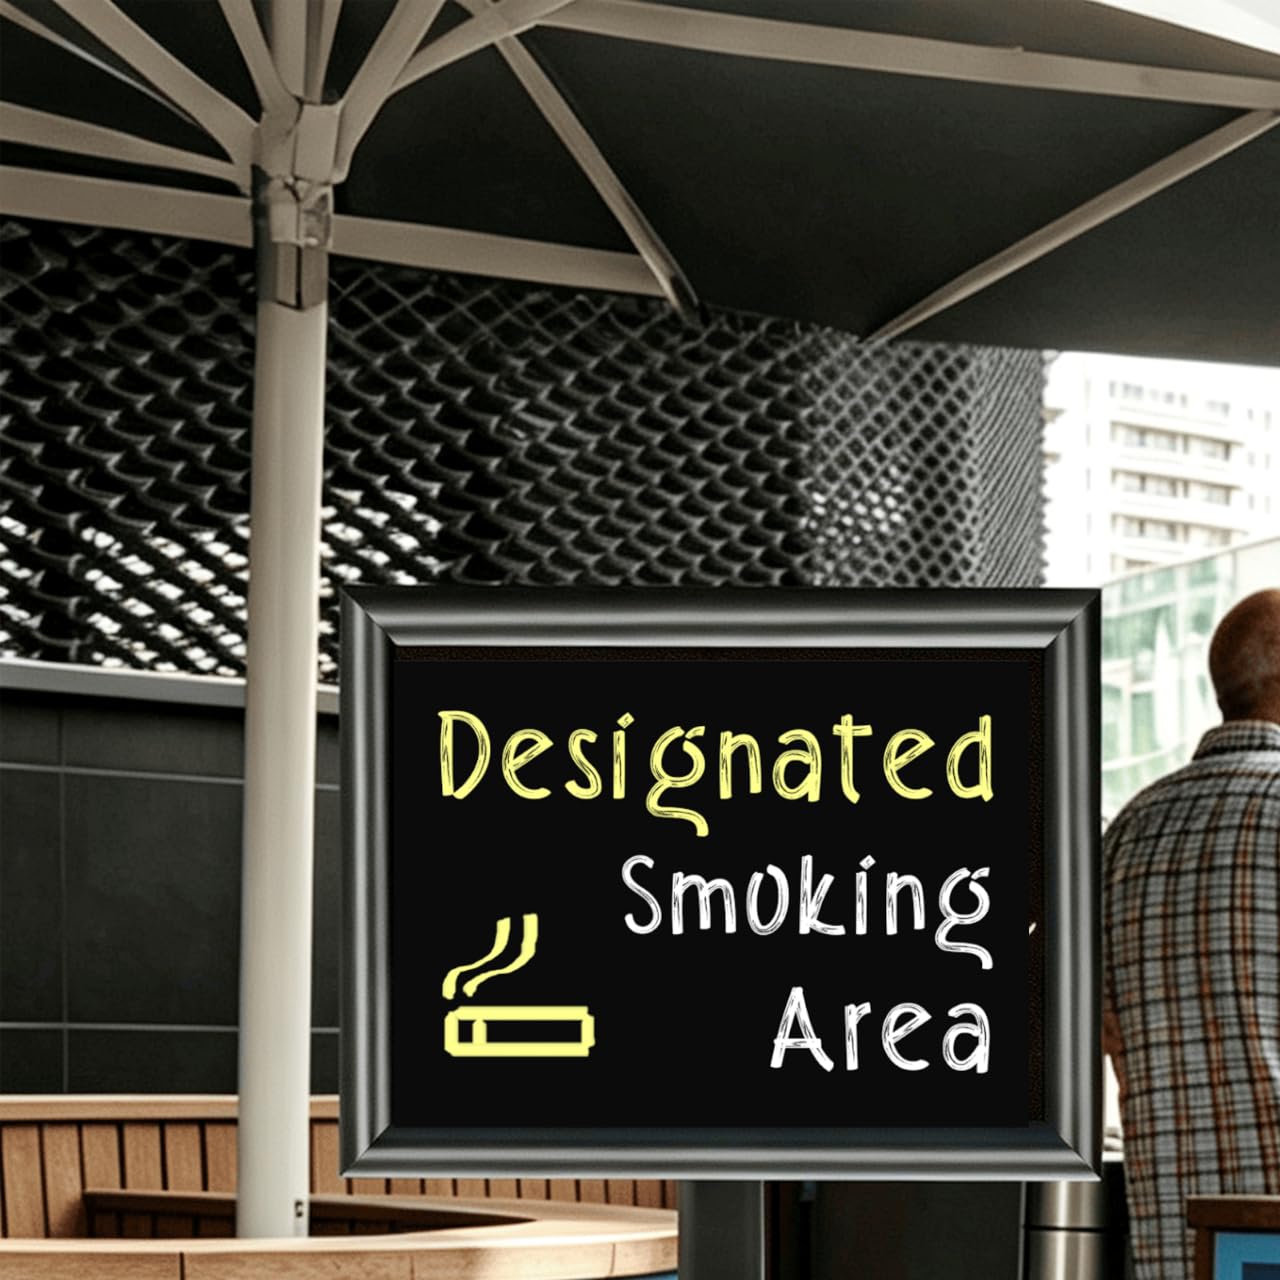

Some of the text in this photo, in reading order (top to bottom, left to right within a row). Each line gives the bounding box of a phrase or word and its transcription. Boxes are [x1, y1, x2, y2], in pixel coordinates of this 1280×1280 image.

[437, 710, 994, 837] Designated
[621, 854, 994, 970] Smoking
[769, 986, 991, 1074] Area
